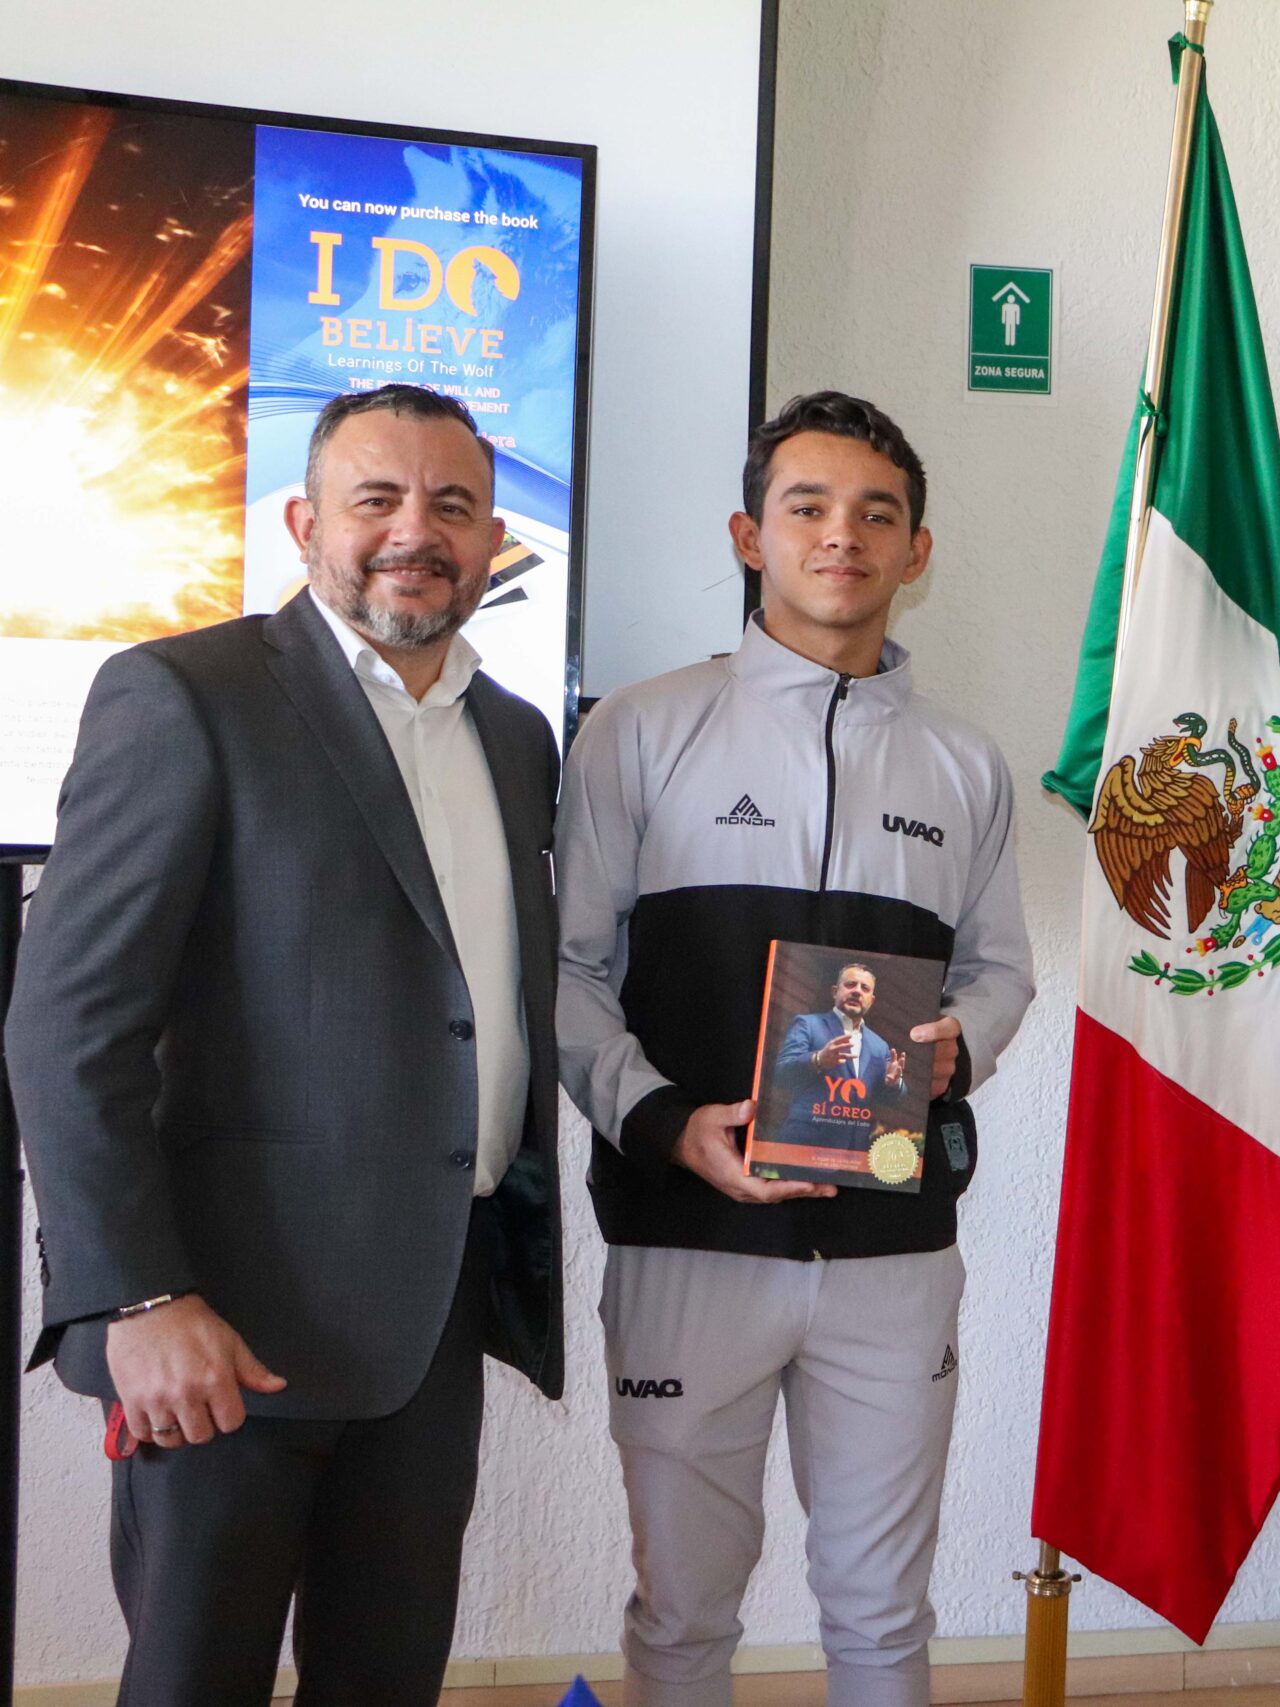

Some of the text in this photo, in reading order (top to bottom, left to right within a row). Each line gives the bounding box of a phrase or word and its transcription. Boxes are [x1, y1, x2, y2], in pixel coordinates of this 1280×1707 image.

[298, 193, 539, 230] You can now purchase the book
[308, 231, 342, 306] I
[328, 353, 494, 378] Learnings Of The Wolf
[974, 366, 1045, 379] ZONA SEGURA
[350, 377, 374, 389] THE
[443, 383, 472, 397] WILL
[475, 387, 500, 398] AND
[882, 813, 945, 847] UVAQ
[824, 1075, 867, 1104] YO
[831, 1105, 872, 1120] CREO
[615, 1377, 684, 1399] UVAQ
